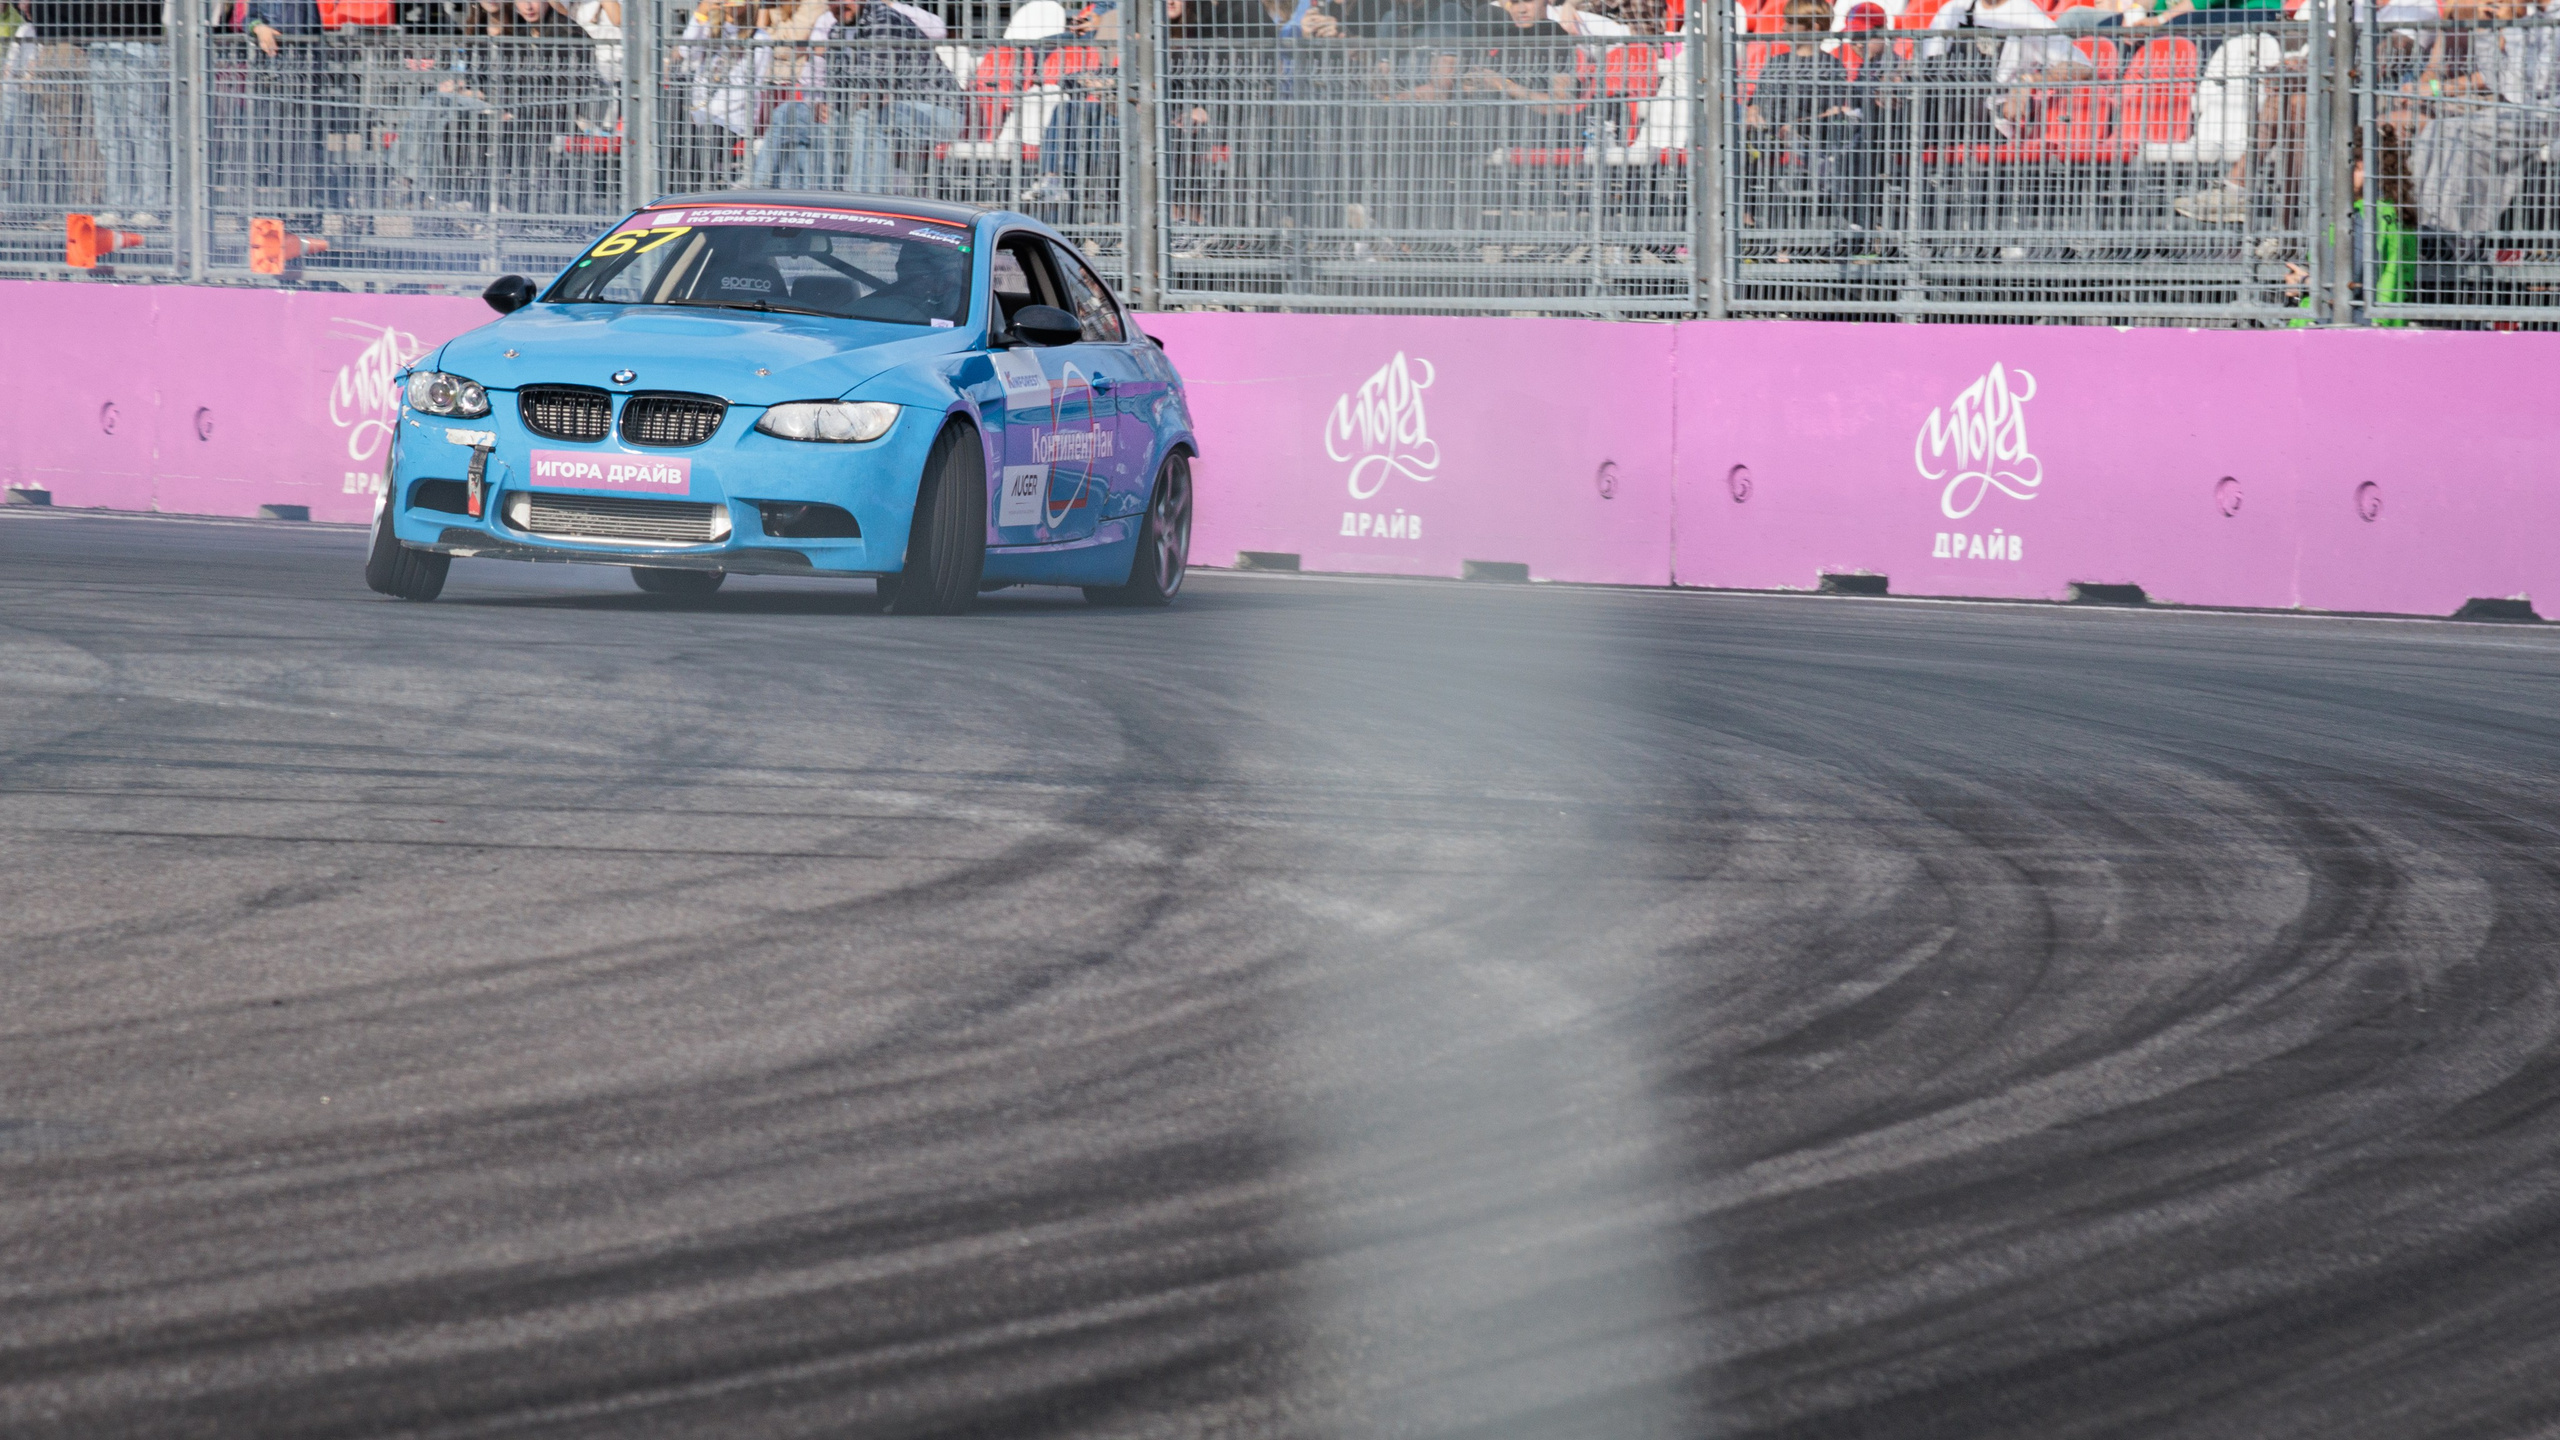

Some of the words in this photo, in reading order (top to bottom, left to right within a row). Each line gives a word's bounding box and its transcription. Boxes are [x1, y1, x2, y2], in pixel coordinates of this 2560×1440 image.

[745, 209, 895, 226] САНКТ-ПЕТЕРБУРГА
[778, 217, 815, 225] 2026
[591, 226, 692, 257] 67
[721, 276, 772, 291] sparco
[342, 472, 380, 494] ДРА
[536, 460, 603, 479] ИГОРА
[607, 463, 682, 484] ДРАЙВ
[1011, 474, 1038, 497] AUGER
[1340, 508, 1422, 539] ДРАЙВ
[1932, 528, 2023, 561] ДРАЙВ
